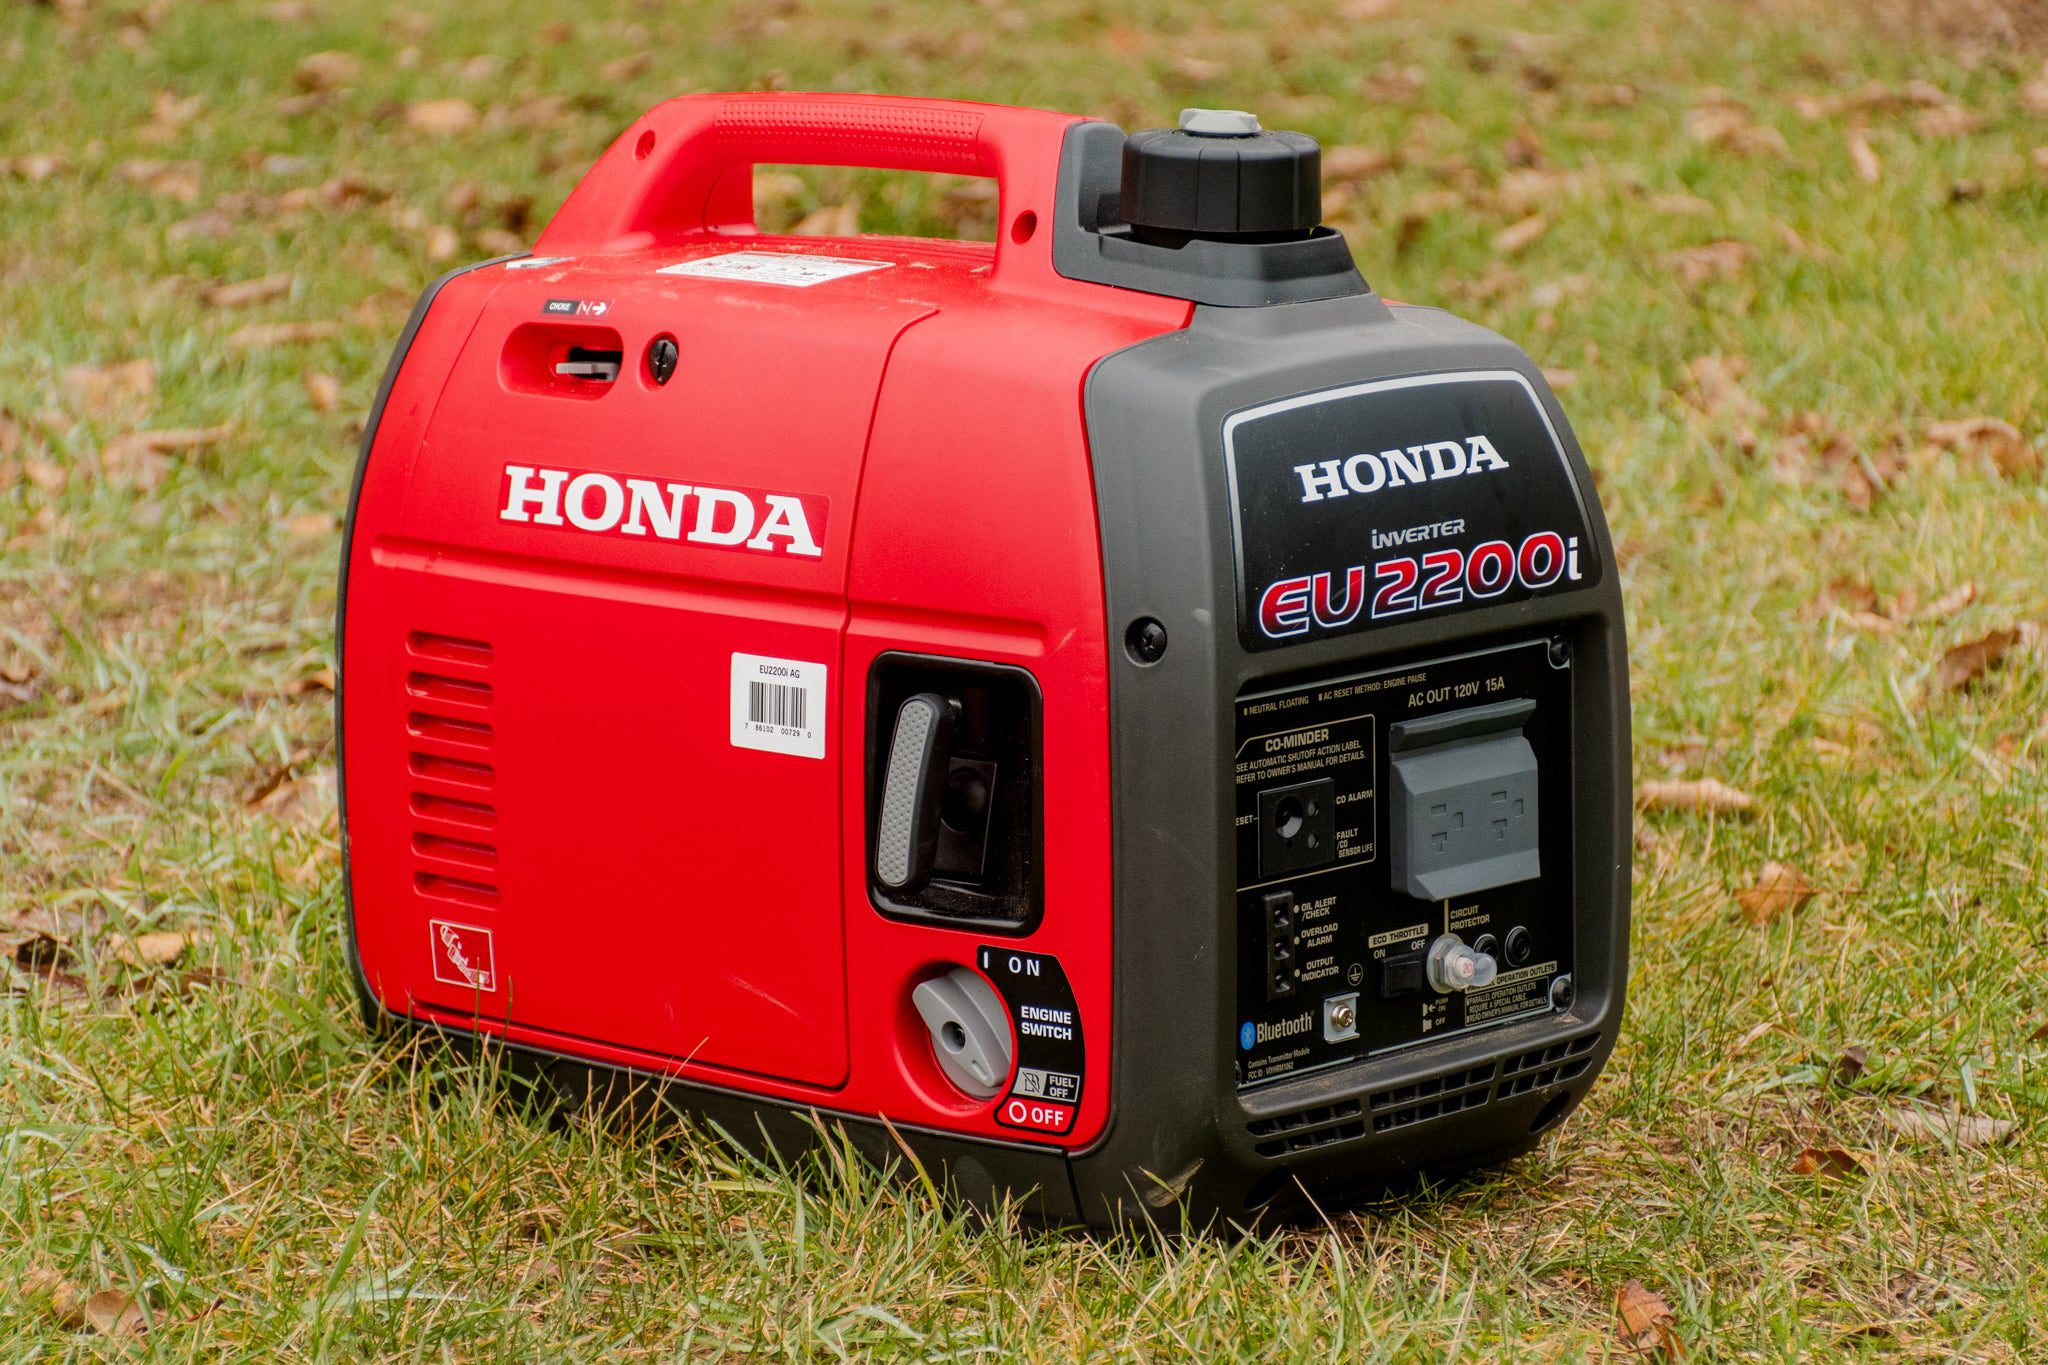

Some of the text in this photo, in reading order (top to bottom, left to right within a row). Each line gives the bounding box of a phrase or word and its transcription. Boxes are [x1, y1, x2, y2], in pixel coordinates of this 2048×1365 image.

[549, 302, 572, 311] CHOKE
[1294, 435, 1509, 502] HONDA
[500, 465, 822, 556] HONDA
[760, 664, 800, 678] EU2200i AG
[1324, 673, 1427, 700] AC RESET METHOD: ENGINE PAUSE
[1408, 676, 1505, 708] AC OUT 120V 15A
[1249, 696, 1309, 715] NEUTRAL FLOATING
[755, 725, 774, 733] 86102
[781, 728, 800, 737] 00729
[1265, 728, 1329, 752] CO-MINDER
[1236, 762, 1248, 773] SEE
[1249, 755, 1286, 770] AUTOMATIC
[1288, 748, 1316, 762] SHUTOFF
[1317, 744, 1340, 756] ACTION
[1236, 750, 1366, 784] REFER TO OWNER'S MANUAL FOR DETAILS.
[1336, 789, 1373, 805] CO ALARM
[1236, 815, 1253, 826] ESET
[1336, 828, 1358, 840] FAULT
[1336, 840, 1348, 850] /CO
[1338, 843, 1373, 858] SENSOR LIFE
[1301, 896, 1337, 912] OIL ALERT
[1301, 907, 1330, 922] /CHECK
[1450, 905, 1479, 920] CIRCUIT
[1301, 923, 1338, 938] OVERLOAD
[1450, 914, 1490, 931] PROTECTOR
[1307, 935, 1333, 948] ALARM
[1373, 926, 1424, 945] ECO THROTTLE
[1411, 939, 1426, 950] OFF
[1373, 948, 1386, 959] ON
[1306, 956, 1334, 970] OUTPUT
[1463, 963, 1473, 974] 20
[1301, 966, 1339, 982] INDICATOR
[1496, 970, 1529, 984] OPERATION
[1530, 964, 1555, 977] OUTLETS
[1491, 987, 1516, 999] OPERATION
[1517, 982, 1536, 993] OUTLETS
[1469, 1002, 1488, 1013] REQUIRE
[1494, 998, 1511, 1007] SPECIAL
[1470, 1013, 1482, 1022] READ
[1501, 1004, 1519, 1014] MANUAL
[1021, 1005, 1072, 1025] ENGINE
[1435, 1017, 1446, 1026] OFF
[1021, 1022, 1072, 1041] SWITCH
[1256, 1012, 1312, 1043] Bluetooth
[1248, 1047, 1310, 1069] Contains Transmitter Module
[1049, 1076, 1074, 1088] FUEL
[1248, 1070, 1257, 1079] FCC
[1050, 1087, 1068, 1098] OFF
[1031, 1107, 1064, 1126] OFF
